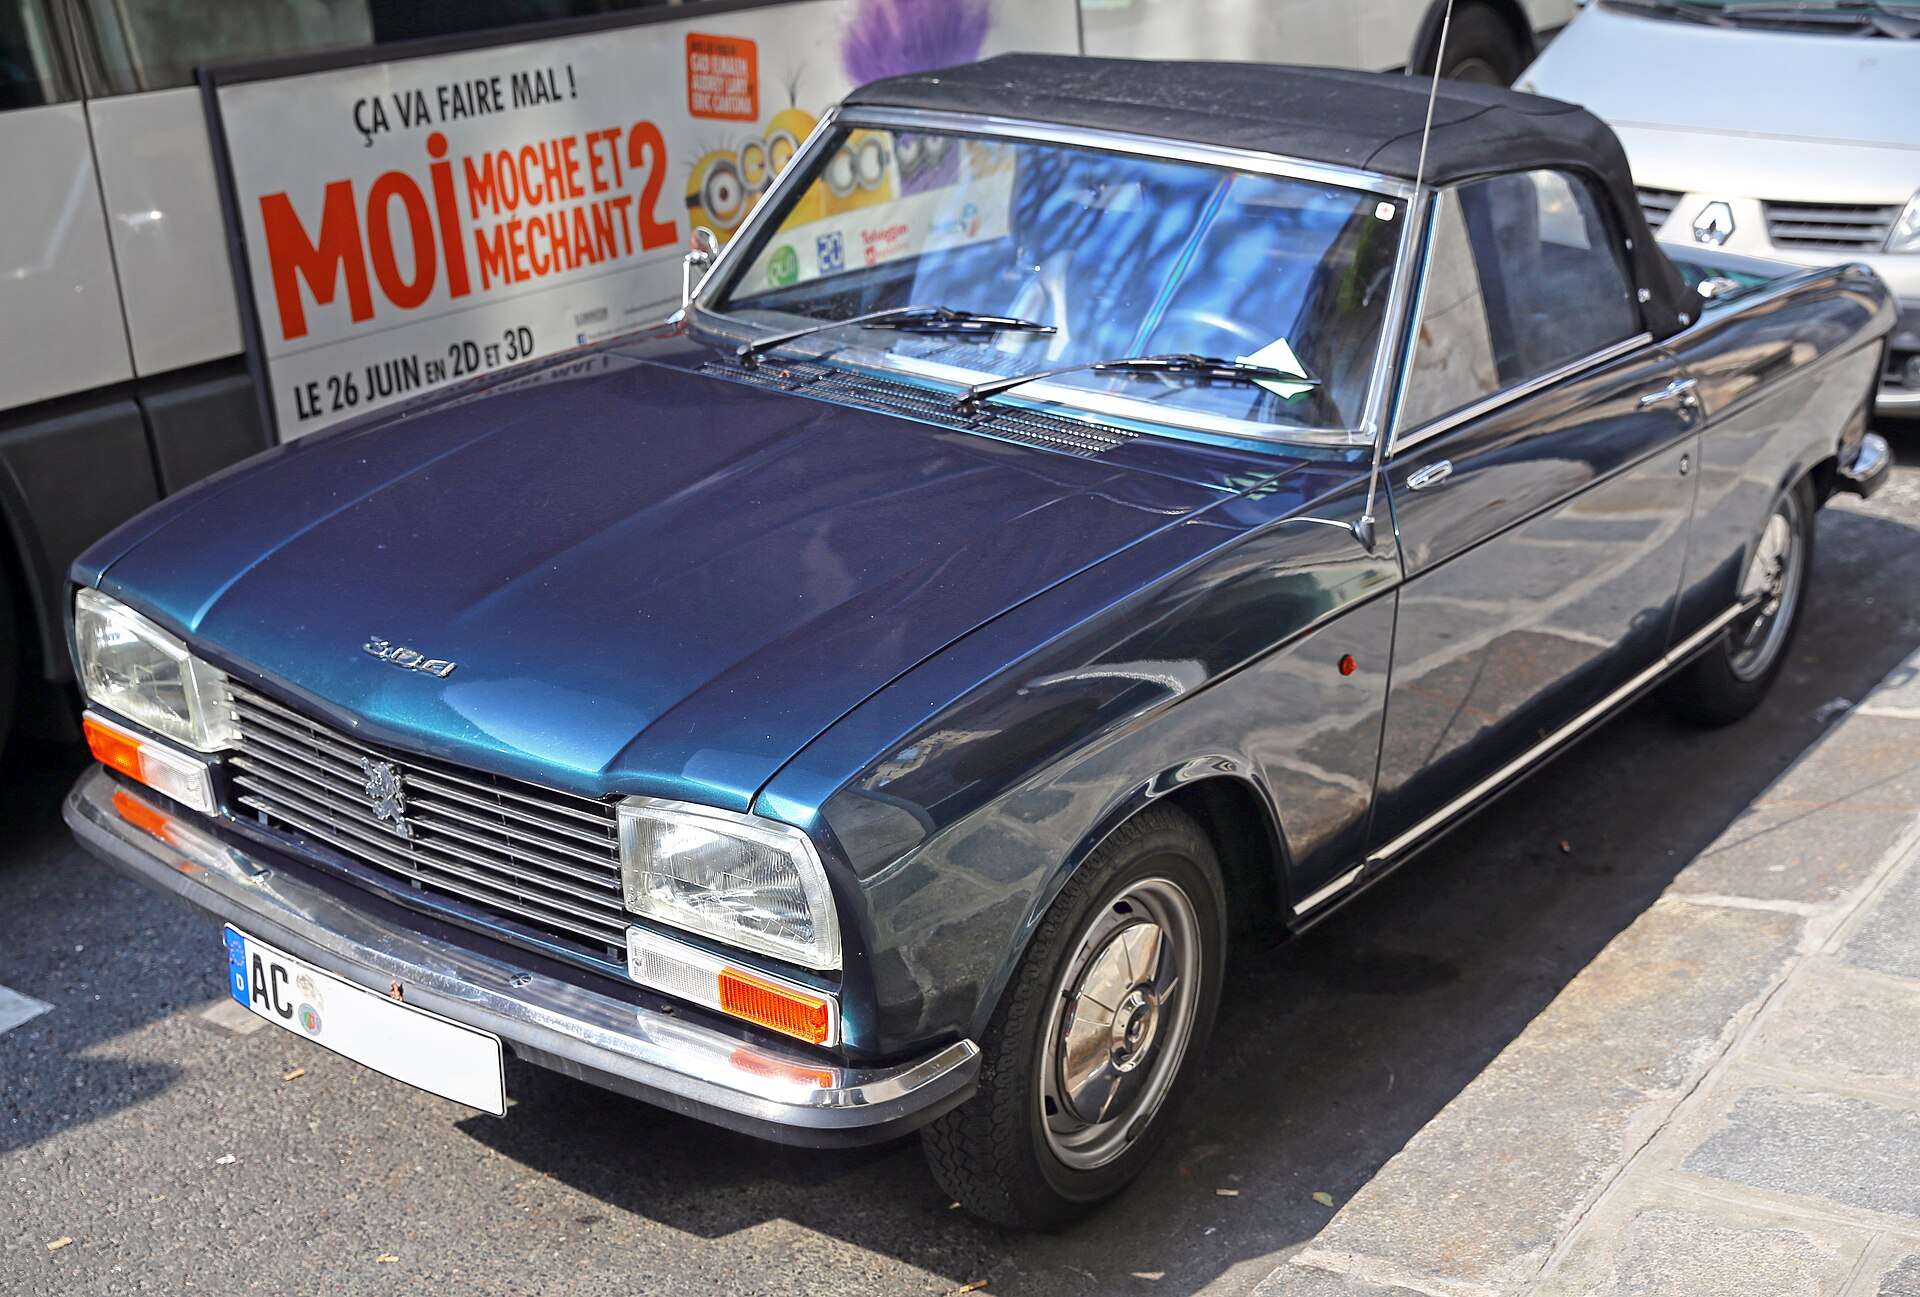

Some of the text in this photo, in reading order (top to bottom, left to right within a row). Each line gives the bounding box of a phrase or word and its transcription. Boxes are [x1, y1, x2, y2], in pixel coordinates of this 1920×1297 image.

[354, 64, 578, 148] ÇA VA FAIRE MAL !
[464, 127, 622, 219] MOCHE ET
[628, 120, 679, 251] 2
[294, 382, 321, 421] LE
[327, 368, 360, 411] 26
[366, 355, 421, 402] JUIN
[425, 360, 448, 384] EN
[448, 341, 480, 378] 2D
[484, 343, 500, 368] ET
[503, 325, 534, 362] 3D
[235, 972, 246, 992] D
[252, 951, 294, 1020] AC
